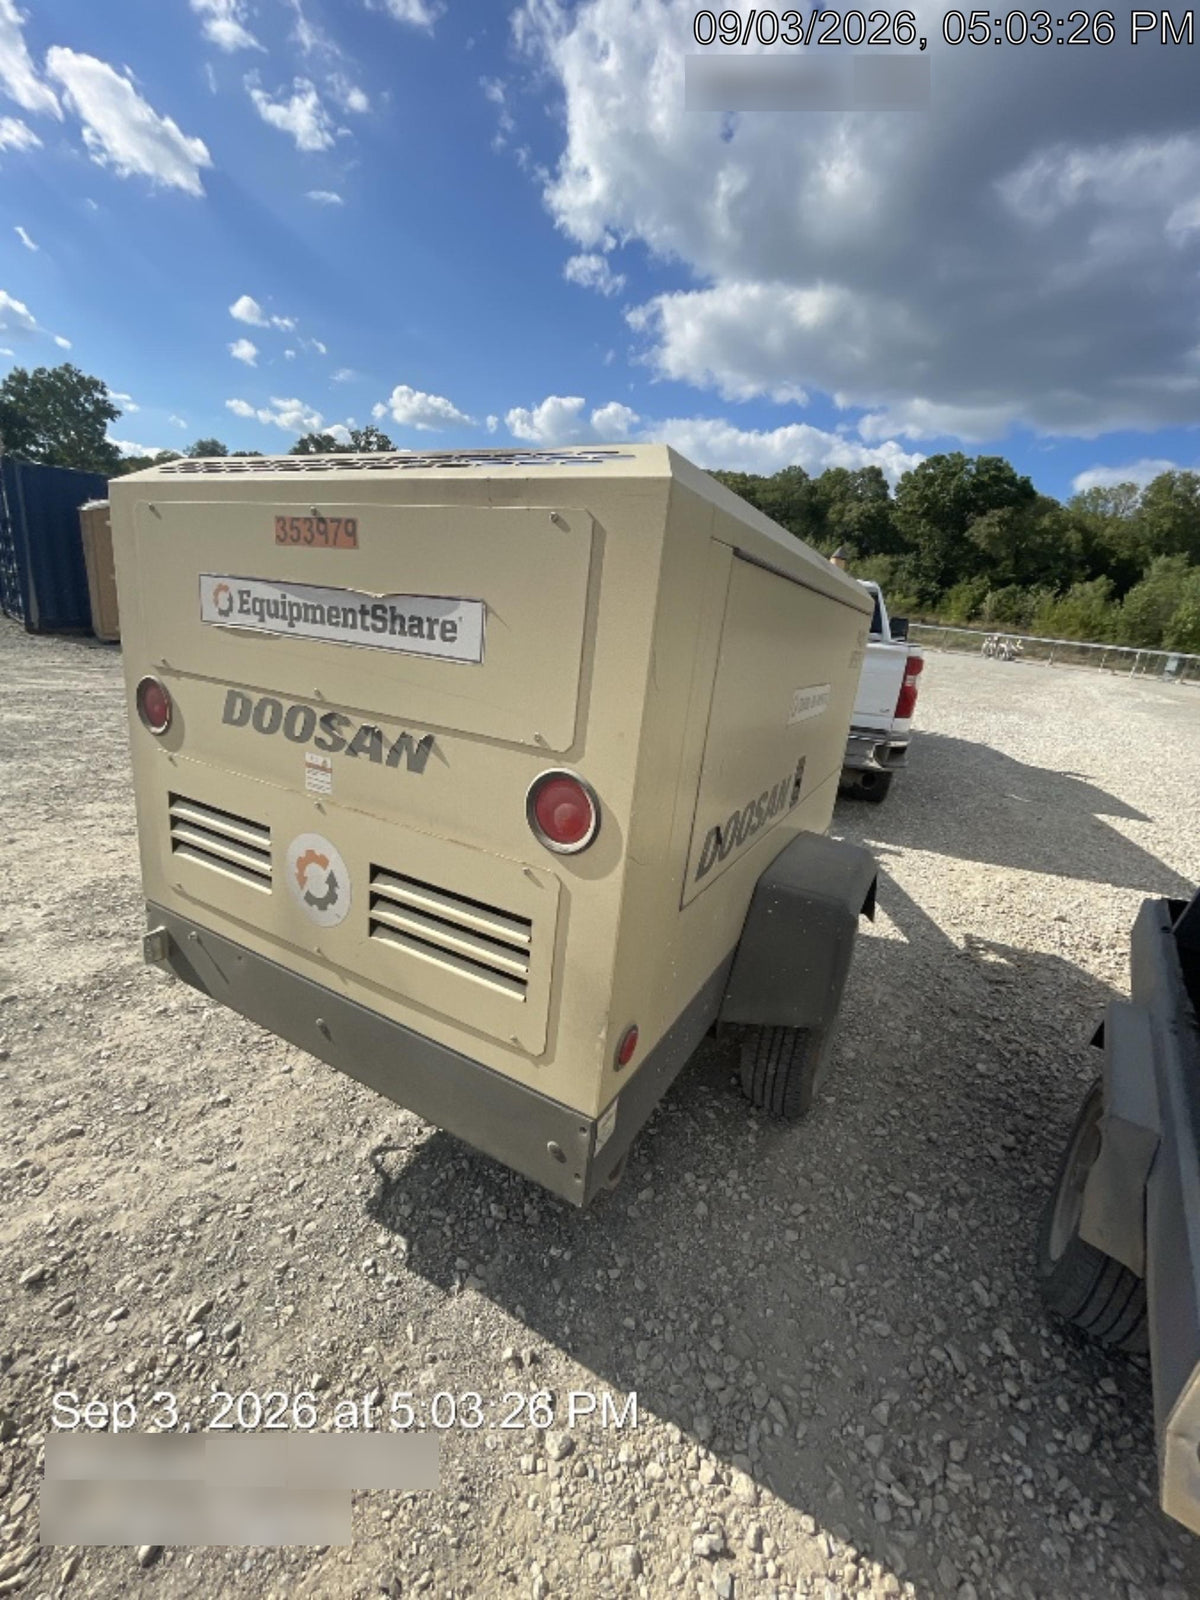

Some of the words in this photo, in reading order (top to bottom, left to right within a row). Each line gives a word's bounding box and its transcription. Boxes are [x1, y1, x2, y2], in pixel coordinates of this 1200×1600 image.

[275, 515, 358, 546] 353979
[237, 589, 458, 643] EquipmentShare
[222, 689, 435, 775] DOOSAN
[695, 774, 793, 882] DOOSAN
